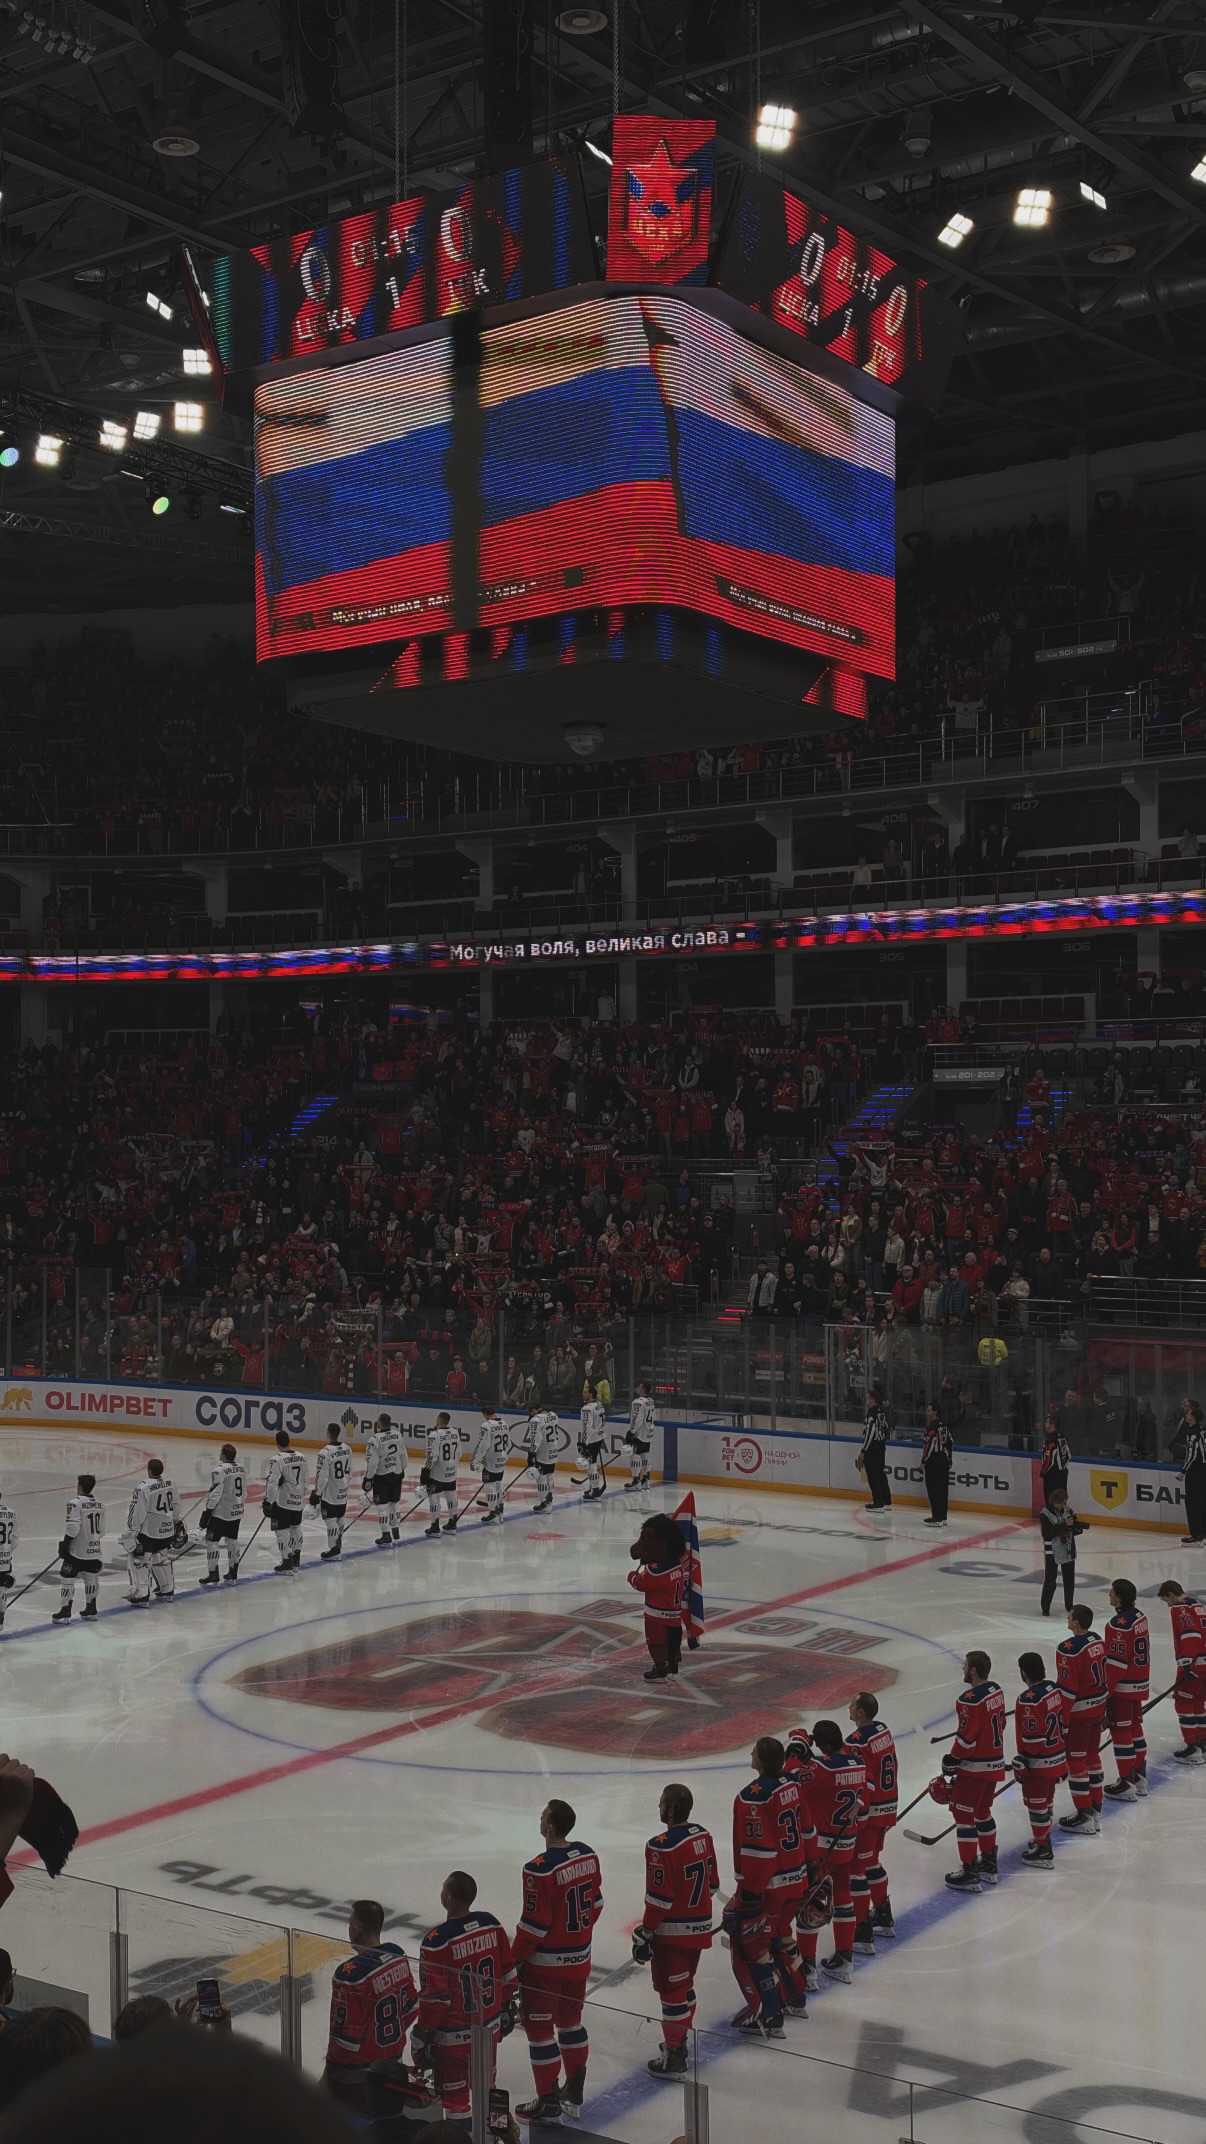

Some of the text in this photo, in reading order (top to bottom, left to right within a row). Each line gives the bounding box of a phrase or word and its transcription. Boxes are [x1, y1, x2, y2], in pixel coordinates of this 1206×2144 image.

[300, 245, 330, 302] 0
[441, 206, 473, 262] 0
[386, 276, 400, 309] 1
[801, 232, 825, 287] 0
[884, 284, 907, 337] 0
[842, 307, 854, 338] 1
[450, 943, 525, 963] Могучая
[530, 939, 580, 958] воля,
[585, 934, 665, 954] великая
[671, 930, 730, 947] слава
[45, 1391, 173, 1418] OLIMPBET
[442, 1441, 458, 1461] 87
[494, 1433, 509, 1453] 28
[234, 1477, 242, 1497] 9
[291, 1466, 301, 1486] 7
[156, 1491, 174, 1513] 40
[87, 1513, 103, 1536] 10
[880, 1753, 898, 1792] 6
[831, 1788, 865, 1828] 2
[565, 1879, 593, 1934] 15
[459, 1954, 495, 2014] 19
